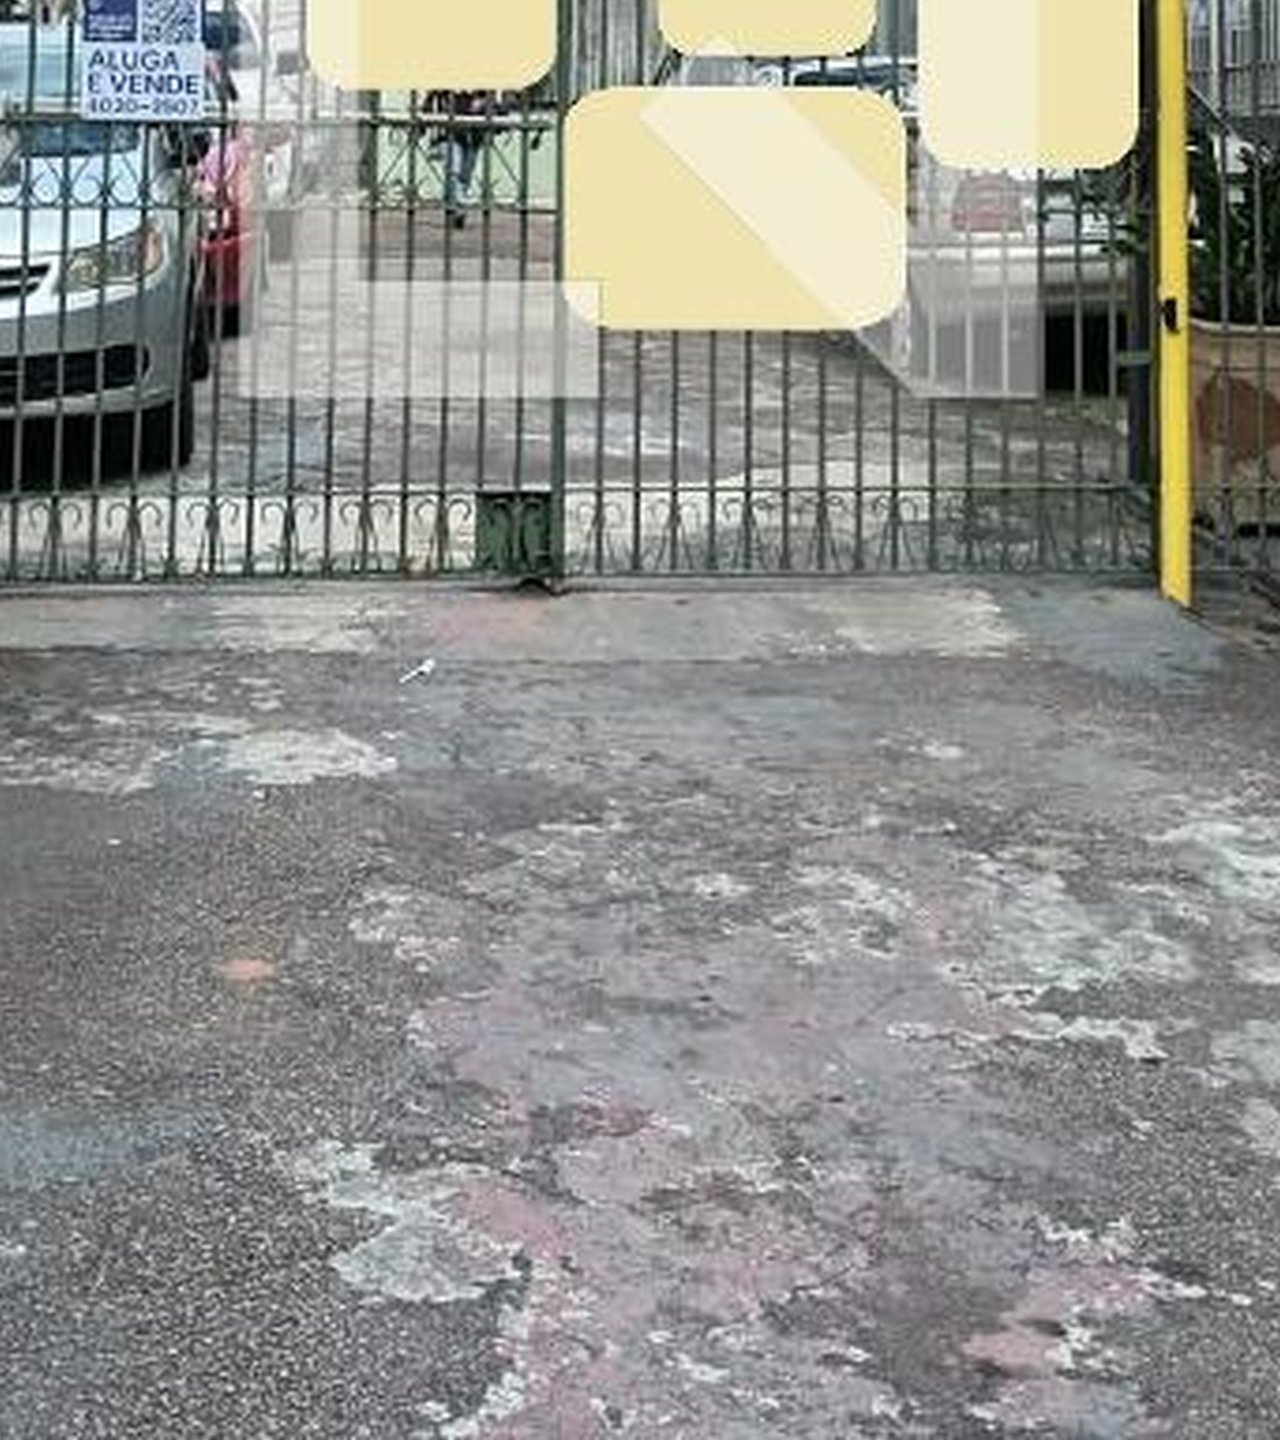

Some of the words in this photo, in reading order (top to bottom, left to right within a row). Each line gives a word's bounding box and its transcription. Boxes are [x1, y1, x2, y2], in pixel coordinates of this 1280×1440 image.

[88, 49, 180, 71] ALUGA
[87, 74, 101, 94] E
[110, 74, 200, 94] VENDE
